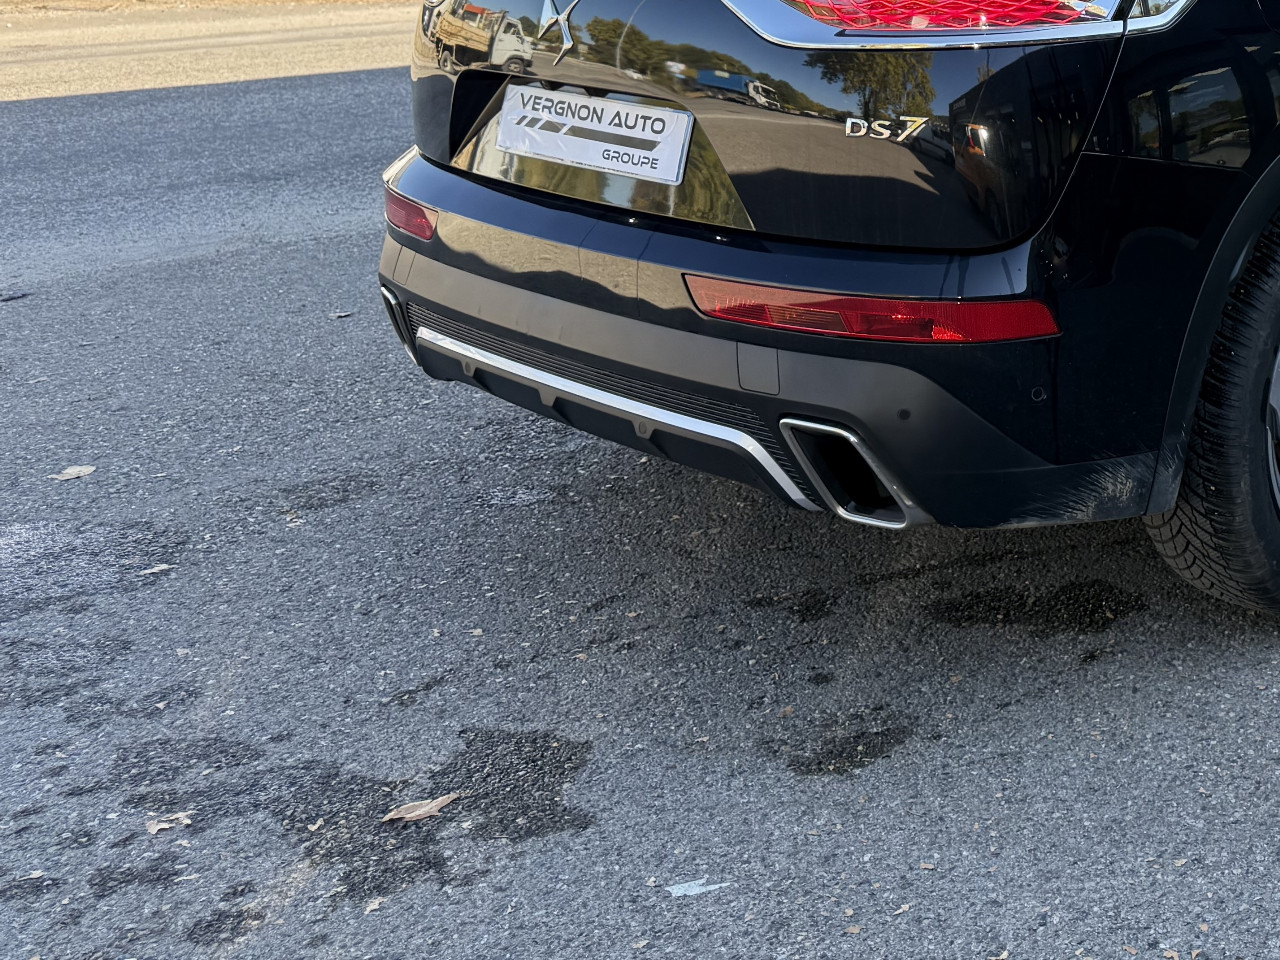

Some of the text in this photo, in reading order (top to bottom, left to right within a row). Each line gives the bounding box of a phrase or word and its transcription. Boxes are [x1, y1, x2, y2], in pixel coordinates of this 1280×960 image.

[520, 92, 667, 135] VERGNON AUTO
[601, 148, 659, 170] GROUPE
